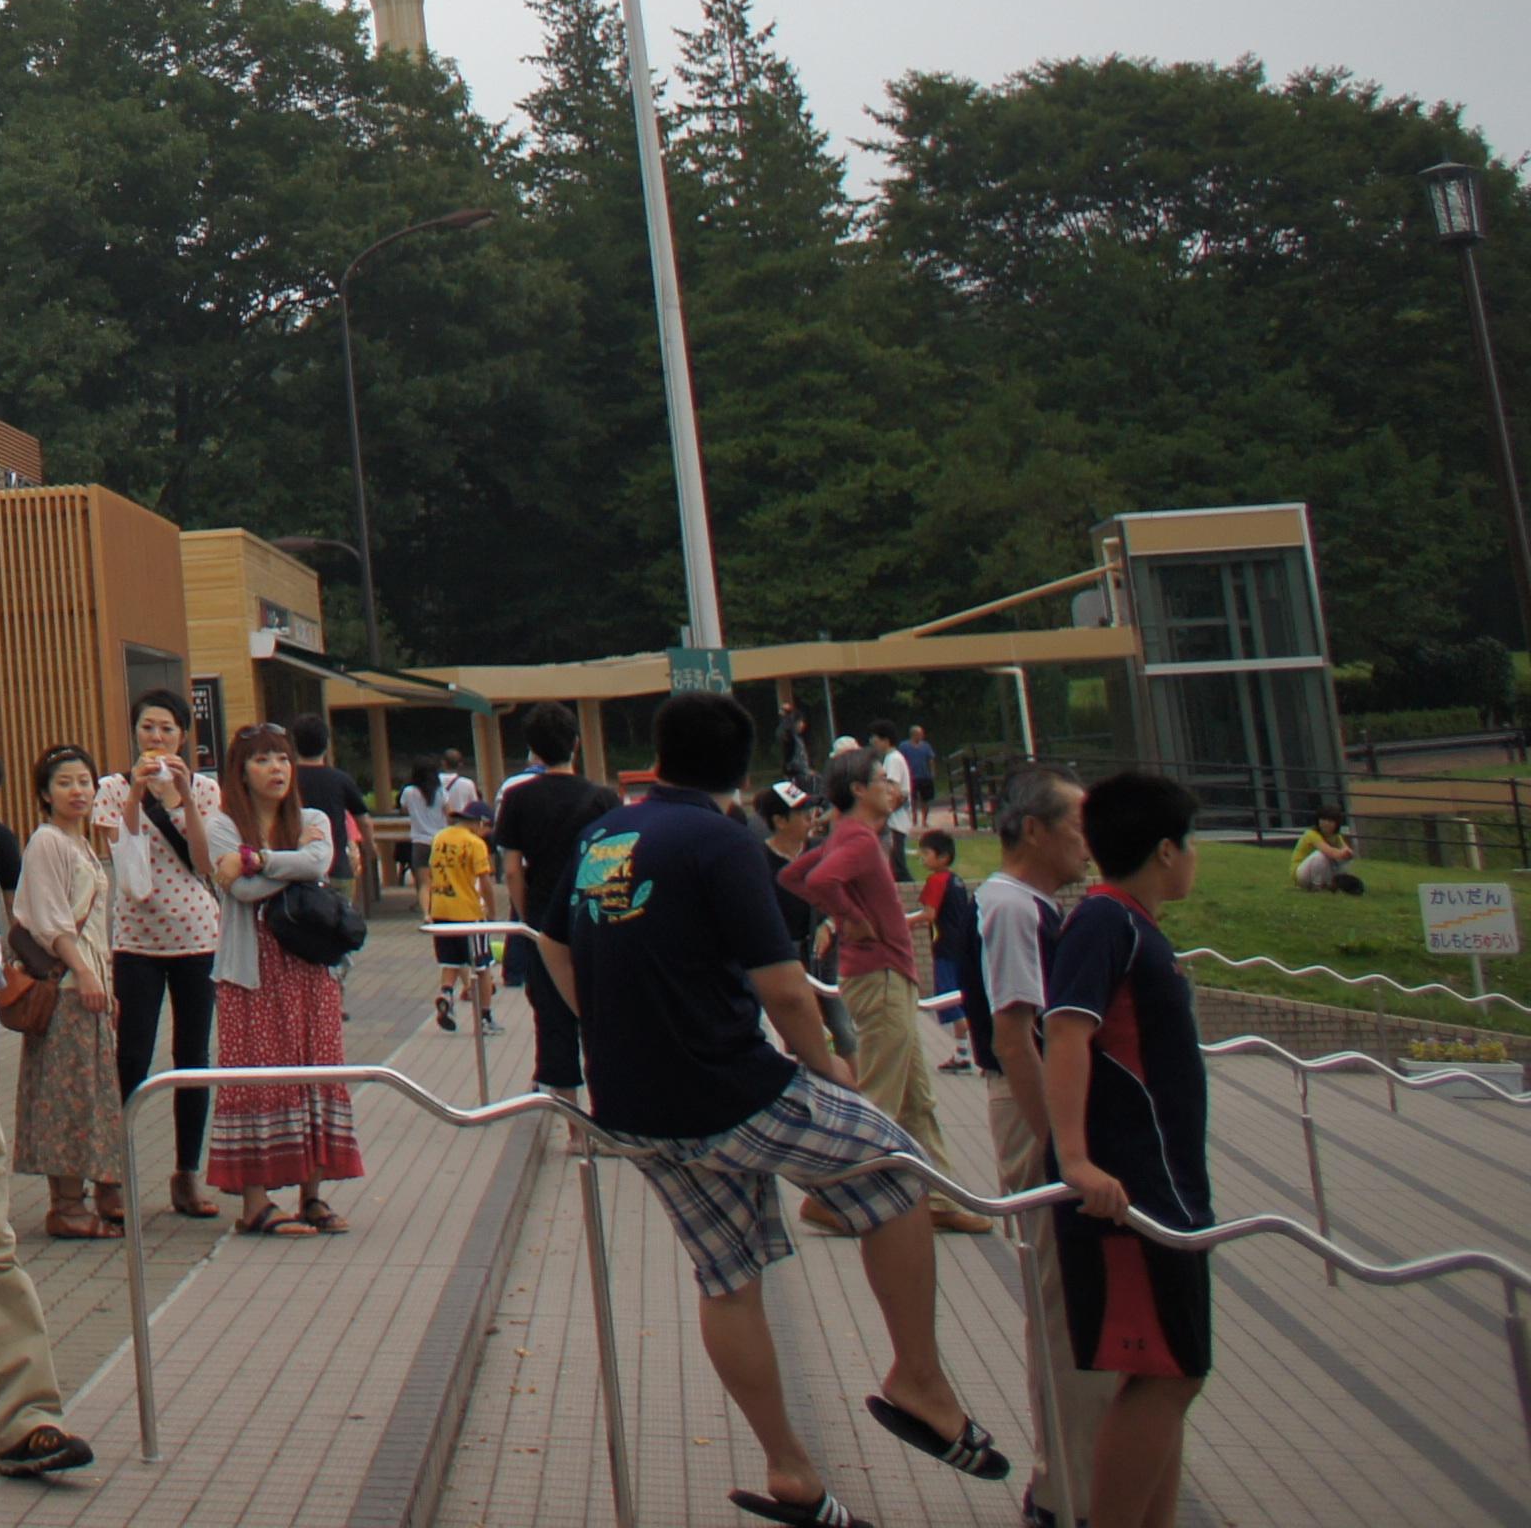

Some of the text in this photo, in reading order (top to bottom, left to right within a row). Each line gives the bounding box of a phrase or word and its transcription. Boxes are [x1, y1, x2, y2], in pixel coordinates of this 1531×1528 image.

[1430, 888, 1501, 905] かいだん
[1430, 933, 1515, 949] あしもとちゅうい
